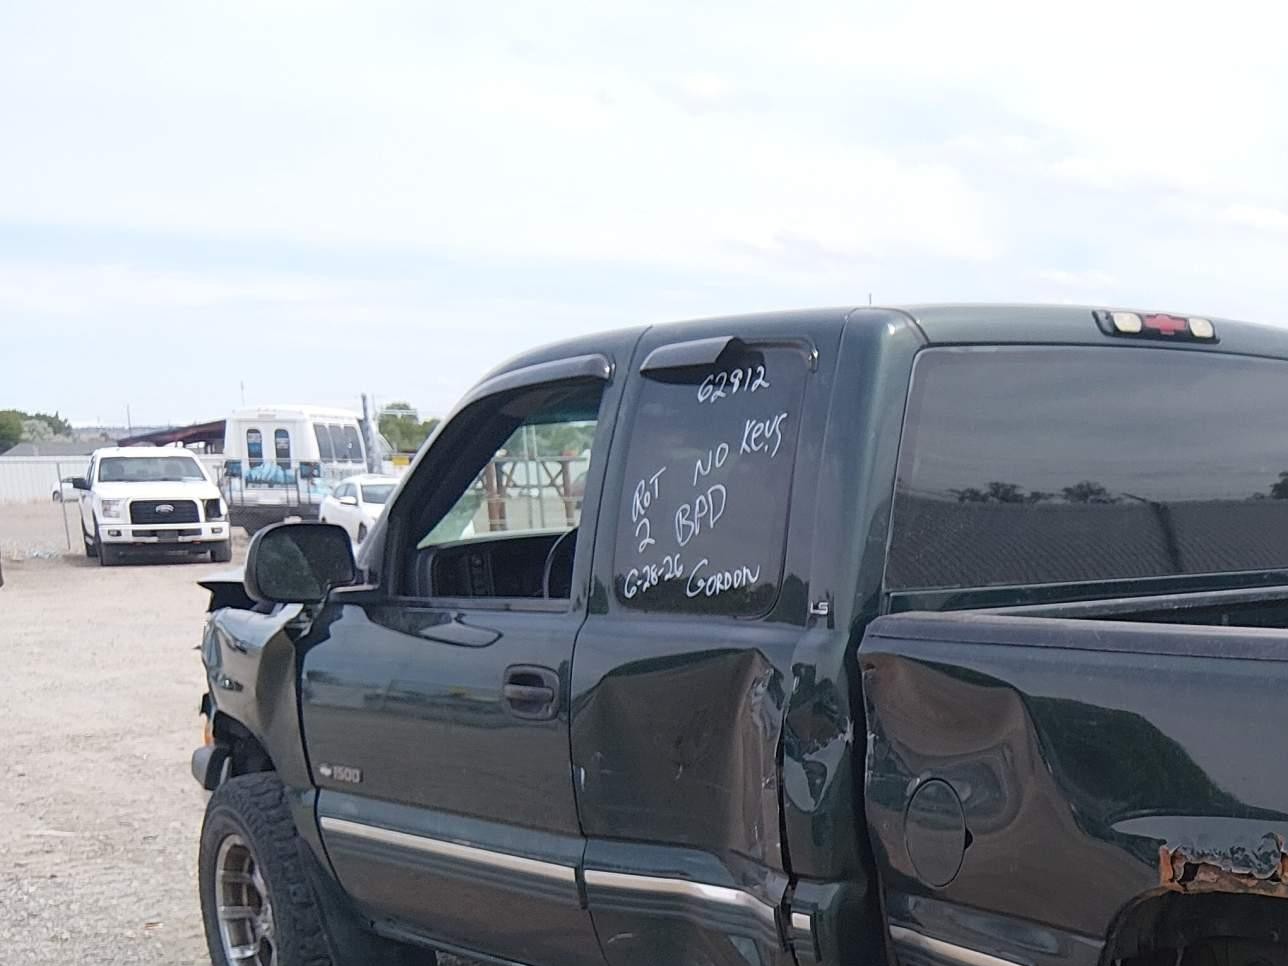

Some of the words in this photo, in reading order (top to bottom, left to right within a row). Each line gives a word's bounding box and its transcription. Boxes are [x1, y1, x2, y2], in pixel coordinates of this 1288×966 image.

[694, 442, 729, 486] NO
[635, 518, 656, 553] 2
[675, 484, 727, 547] BPD
[624, 553, 684, 599] 6-28-26
[810, 600, 829, 615] LS
[333, 765, 361, 783] 1500
